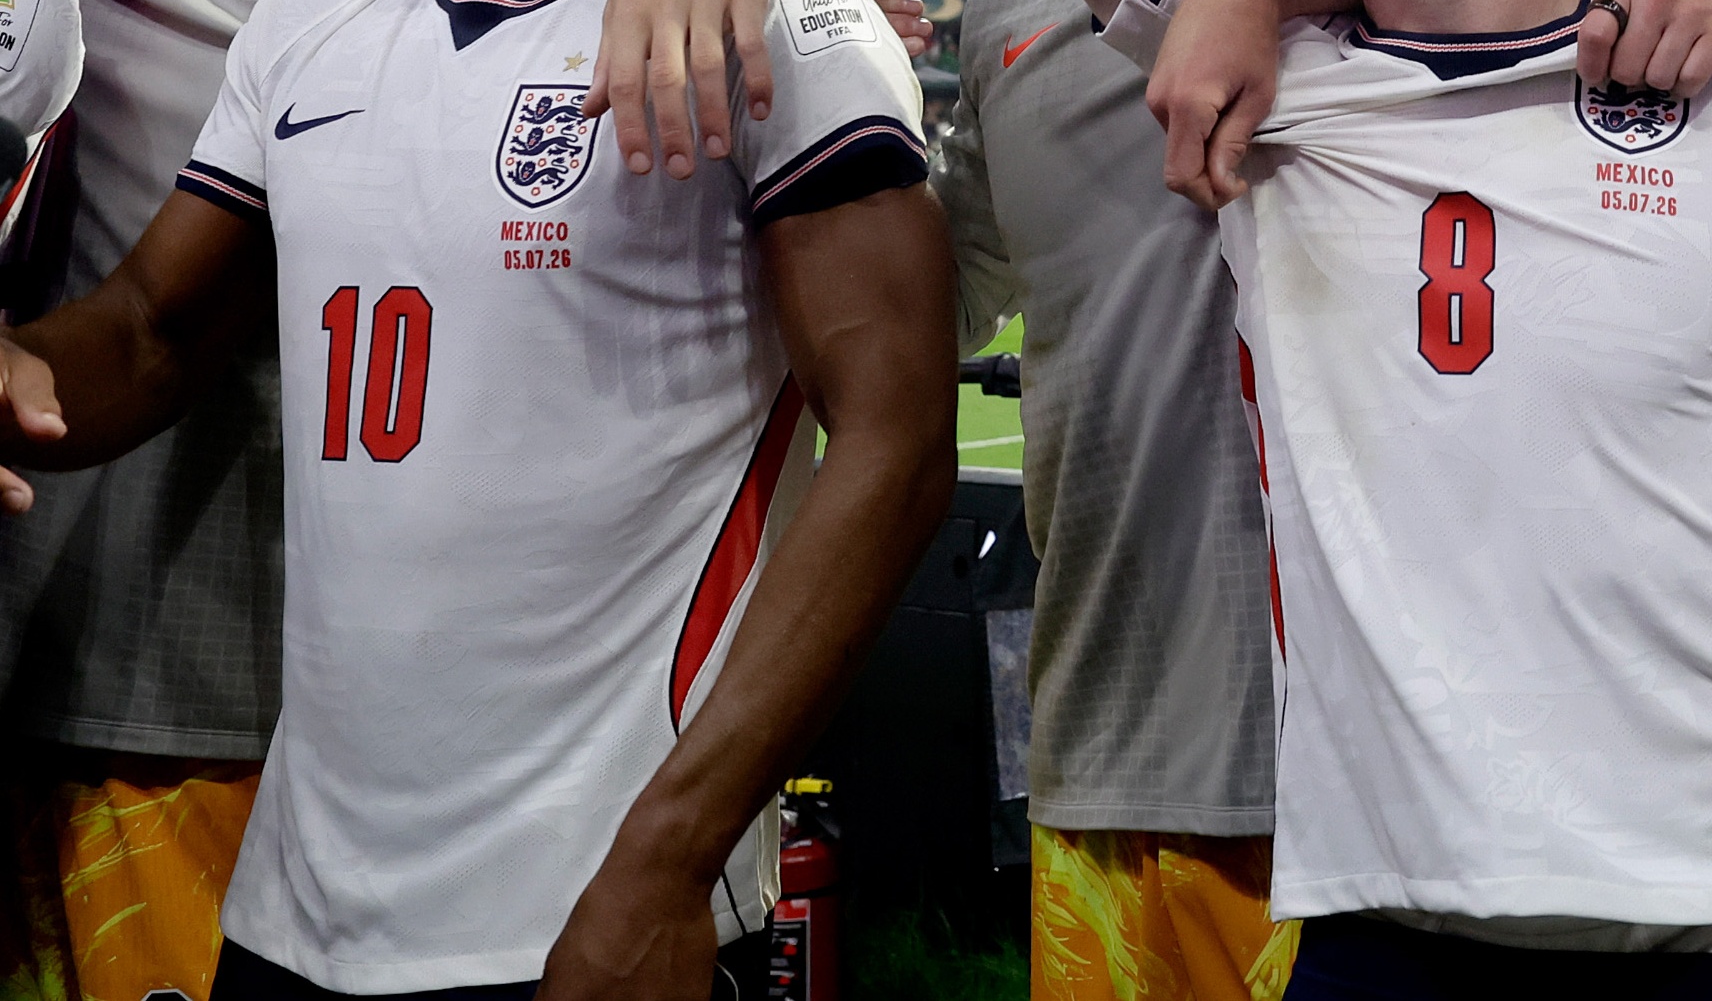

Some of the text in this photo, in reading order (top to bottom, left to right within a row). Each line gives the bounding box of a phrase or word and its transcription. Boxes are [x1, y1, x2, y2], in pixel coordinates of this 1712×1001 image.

[799, 8, 864, 34] EDUCATION
[826, 26, 852, 39] FIFA
[1596, 163, 1674, 188] MEXICO
[1601, 190, 1677, 216] 05.07.26
[500, 220, 569, 241] MEXICO
[504, 249, 571, 270] 05.07.26
[1417, 190, 1496, 375] 8
[321, 285, 434, 464] 10
